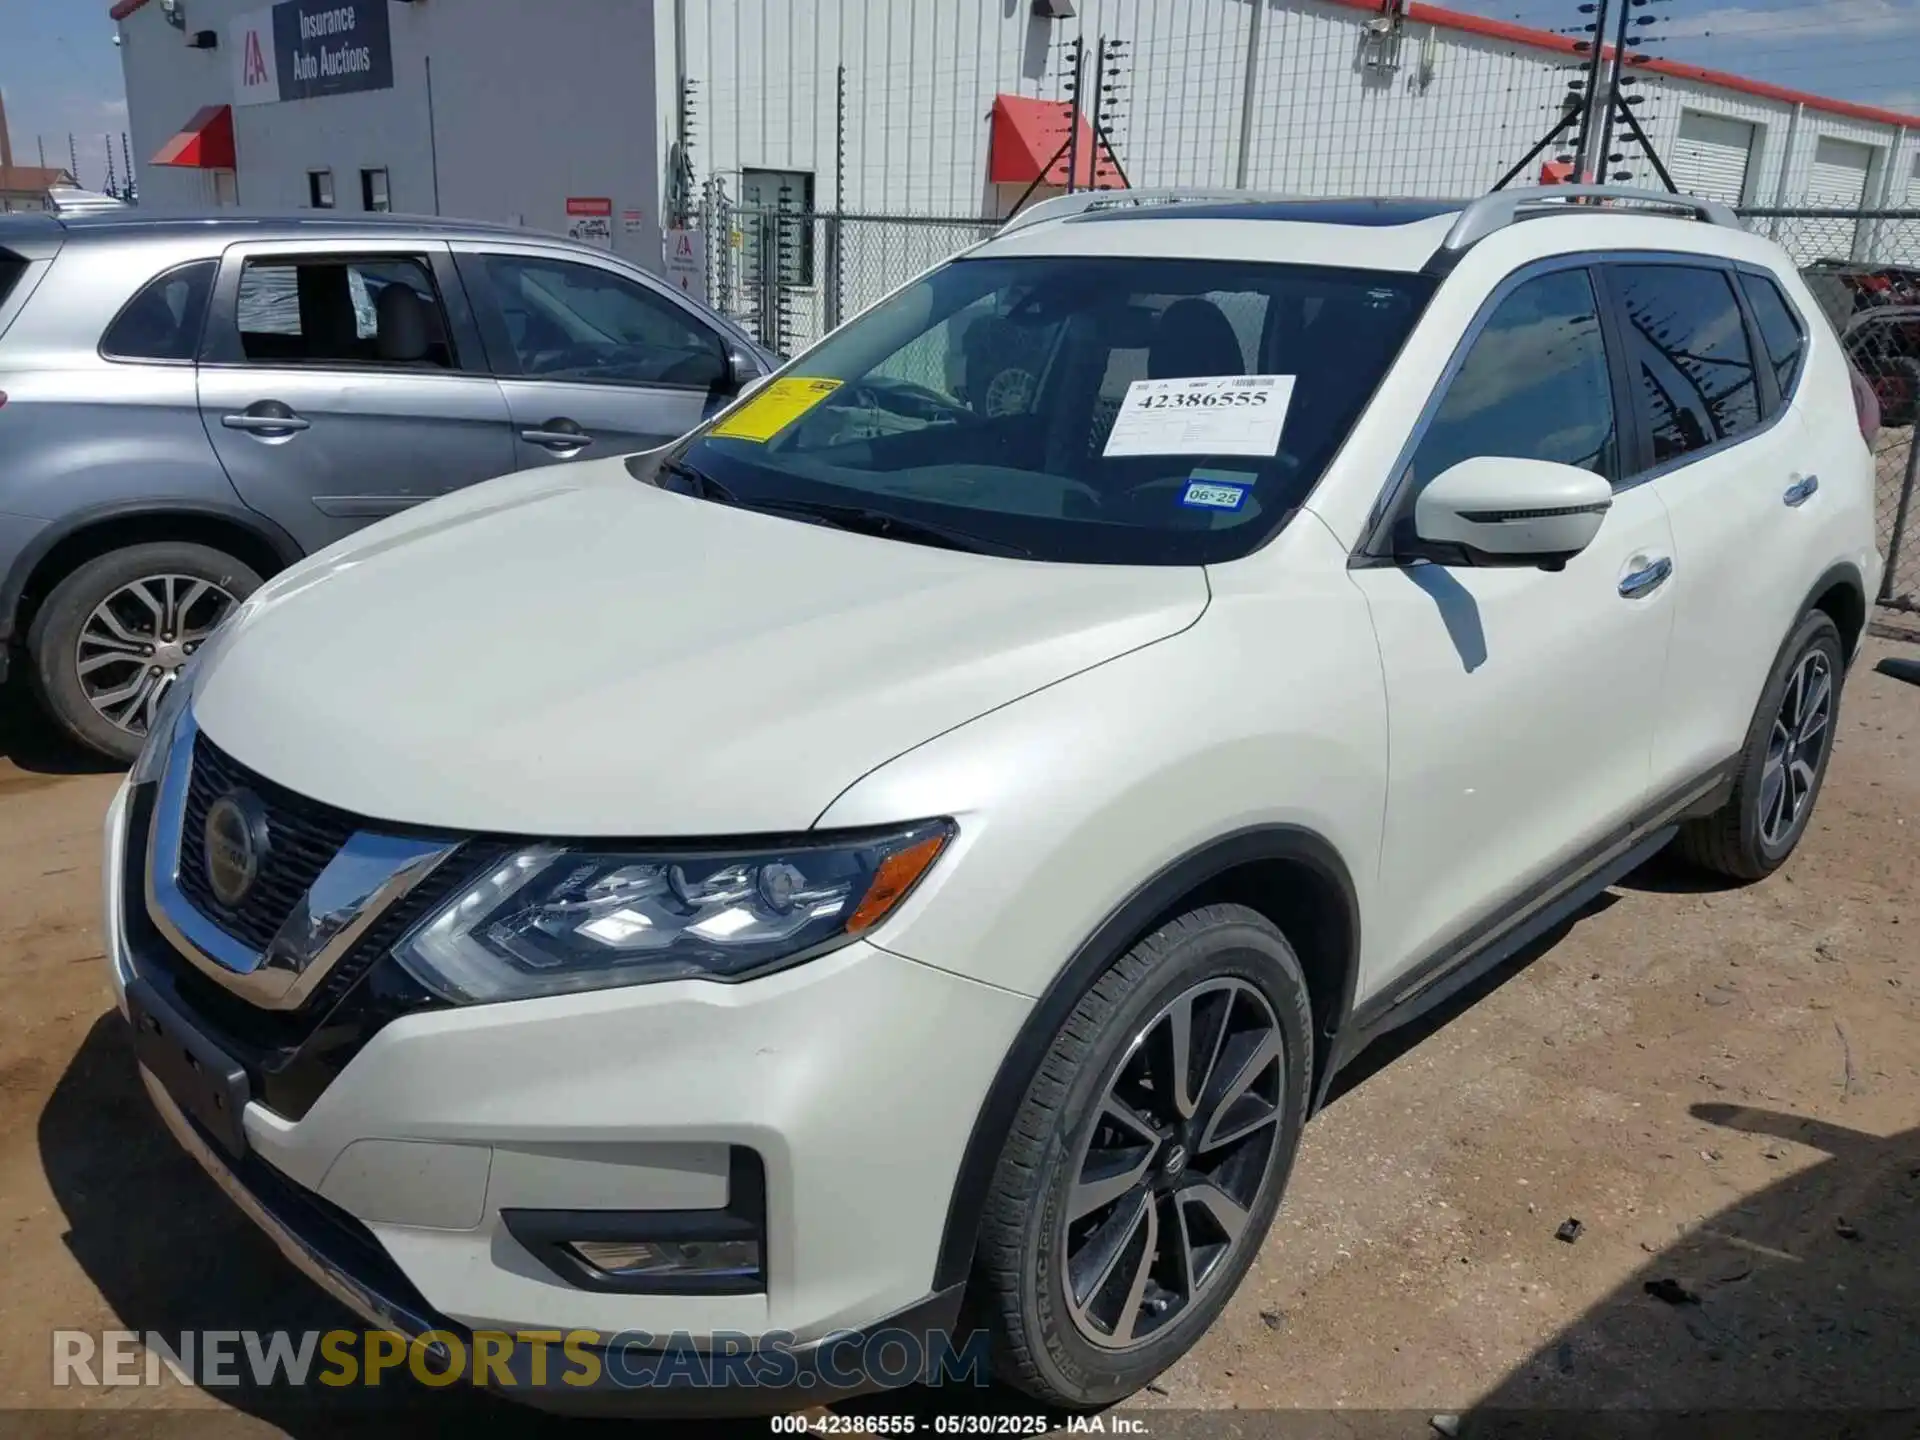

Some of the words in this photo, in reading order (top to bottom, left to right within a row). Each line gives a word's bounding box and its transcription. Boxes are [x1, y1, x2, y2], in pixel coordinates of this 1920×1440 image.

[299, 6, 356, 40] Insurance
[293, 50, 318, 81] Auto
[320, 41, 371, 76] Auctions
[1137, 391, 1268, 409] 42386555
[1037, 1255, 1054, 1333] TRAC
